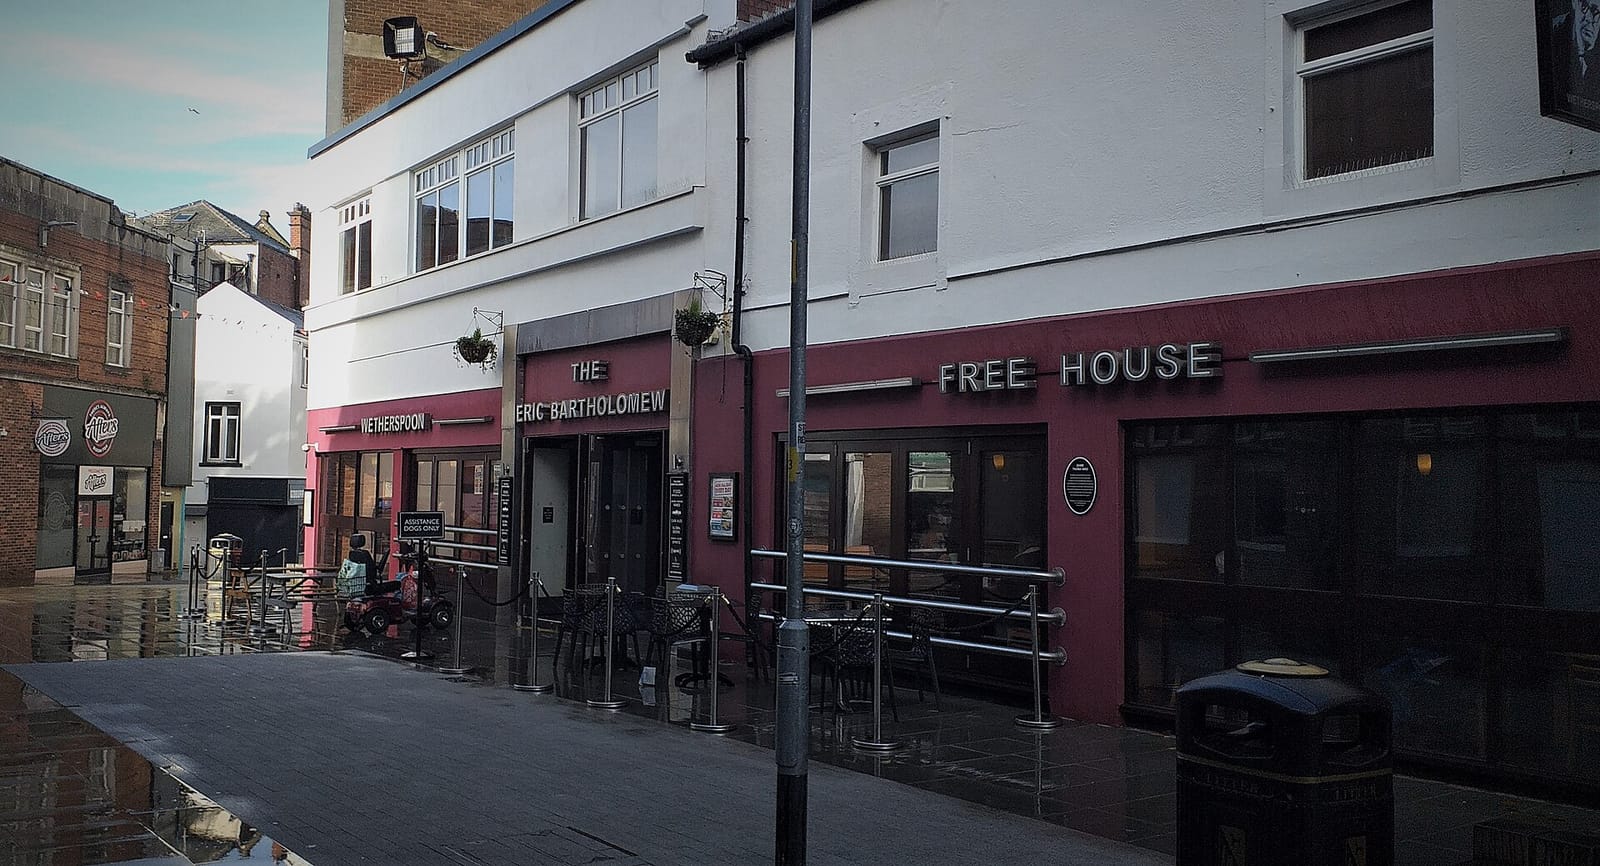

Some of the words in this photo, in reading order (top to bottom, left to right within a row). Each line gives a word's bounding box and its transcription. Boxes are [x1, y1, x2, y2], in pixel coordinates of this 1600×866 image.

[571, 360, 602, 382] THE
[938, 357, 1034, 393] FREE
[1060, 342, 1219, 386] HOUSE
[516, 402, 544, 423] ERIC
[551, 389, 666, 421] BARTHOLOMEW
[85, 417, 118, 442] Afters
[360, 413, 426, 433] WETHERSPOON
[37, 431, 69, 447] Afters
